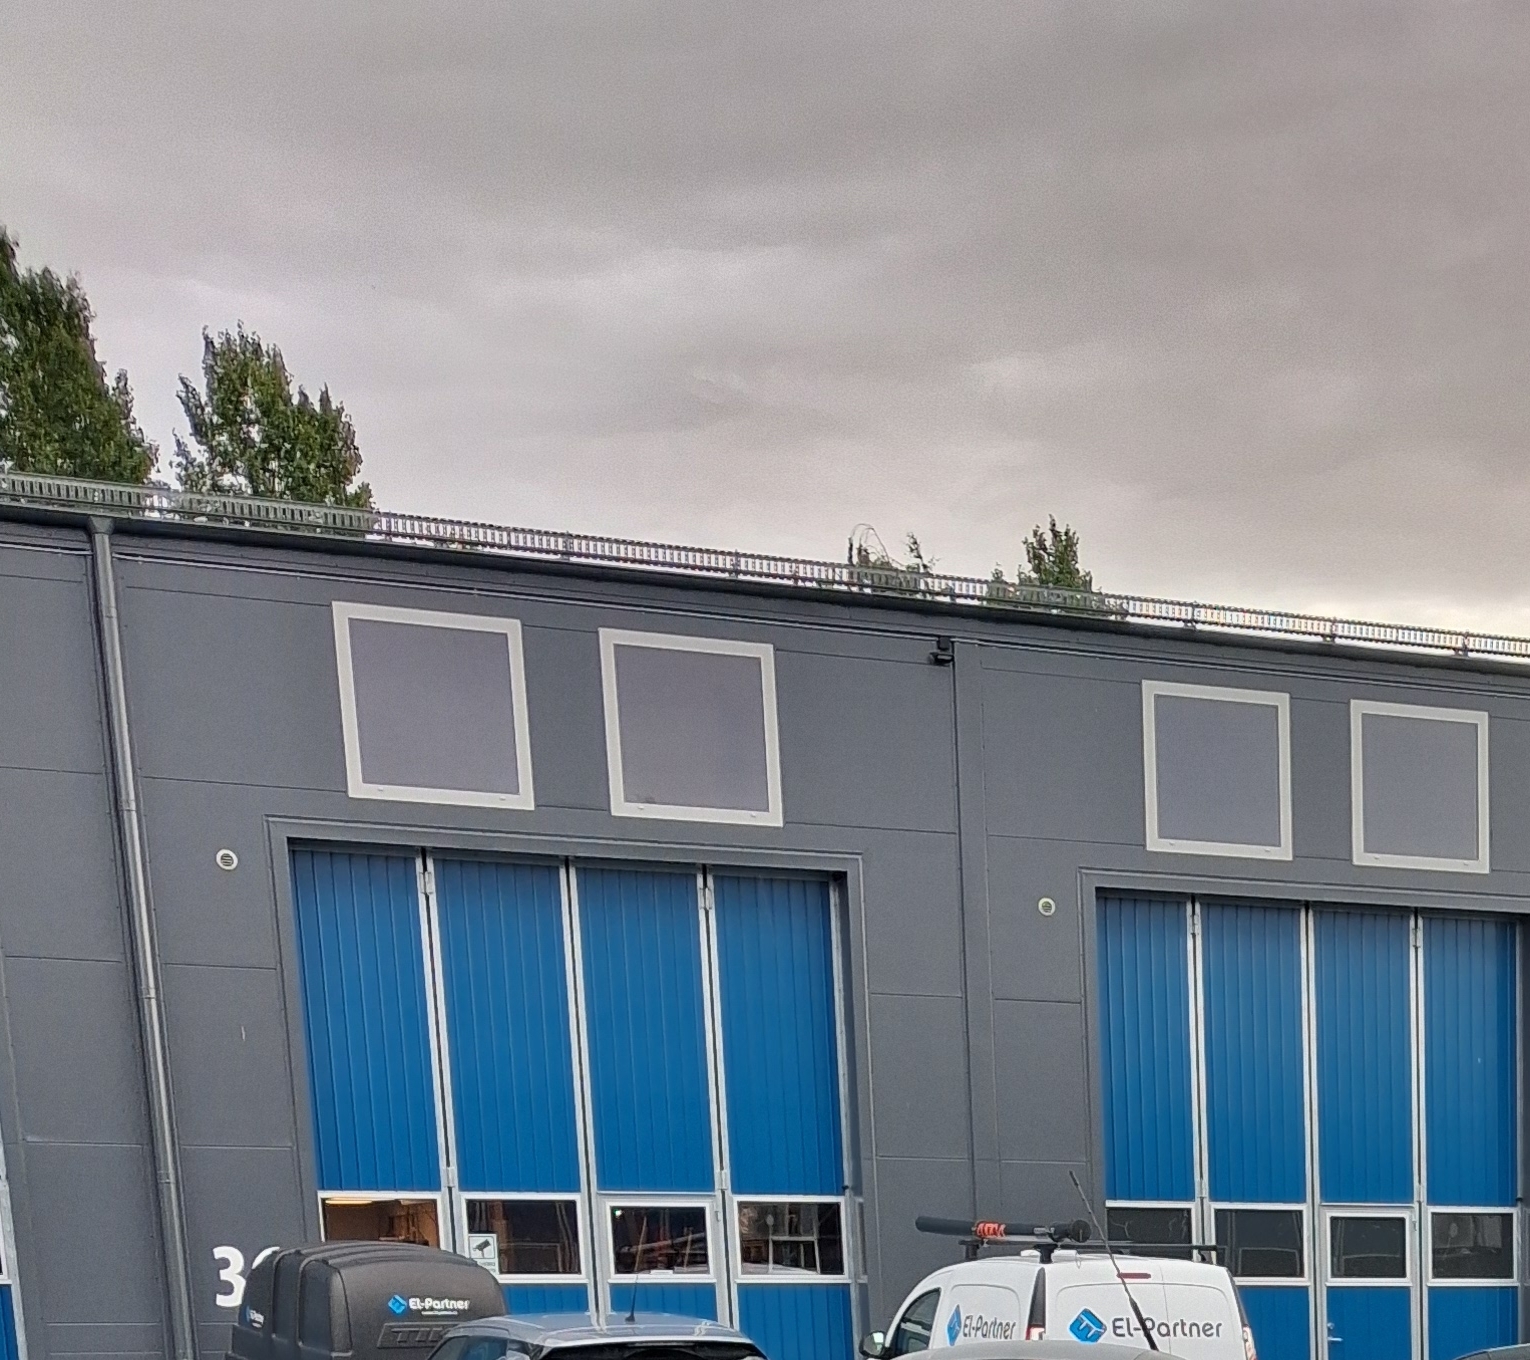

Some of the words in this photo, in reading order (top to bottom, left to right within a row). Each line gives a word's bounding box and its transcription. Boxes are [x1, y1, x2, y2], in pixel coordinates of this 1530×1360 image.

[213, 1246, 280, 1307] 3
[408, 1297, 470, 1310] El-Partner
[962, 1315, 1017, 1340] El-Partner
[1112, 1317, 1222, 1337] El-Partner
